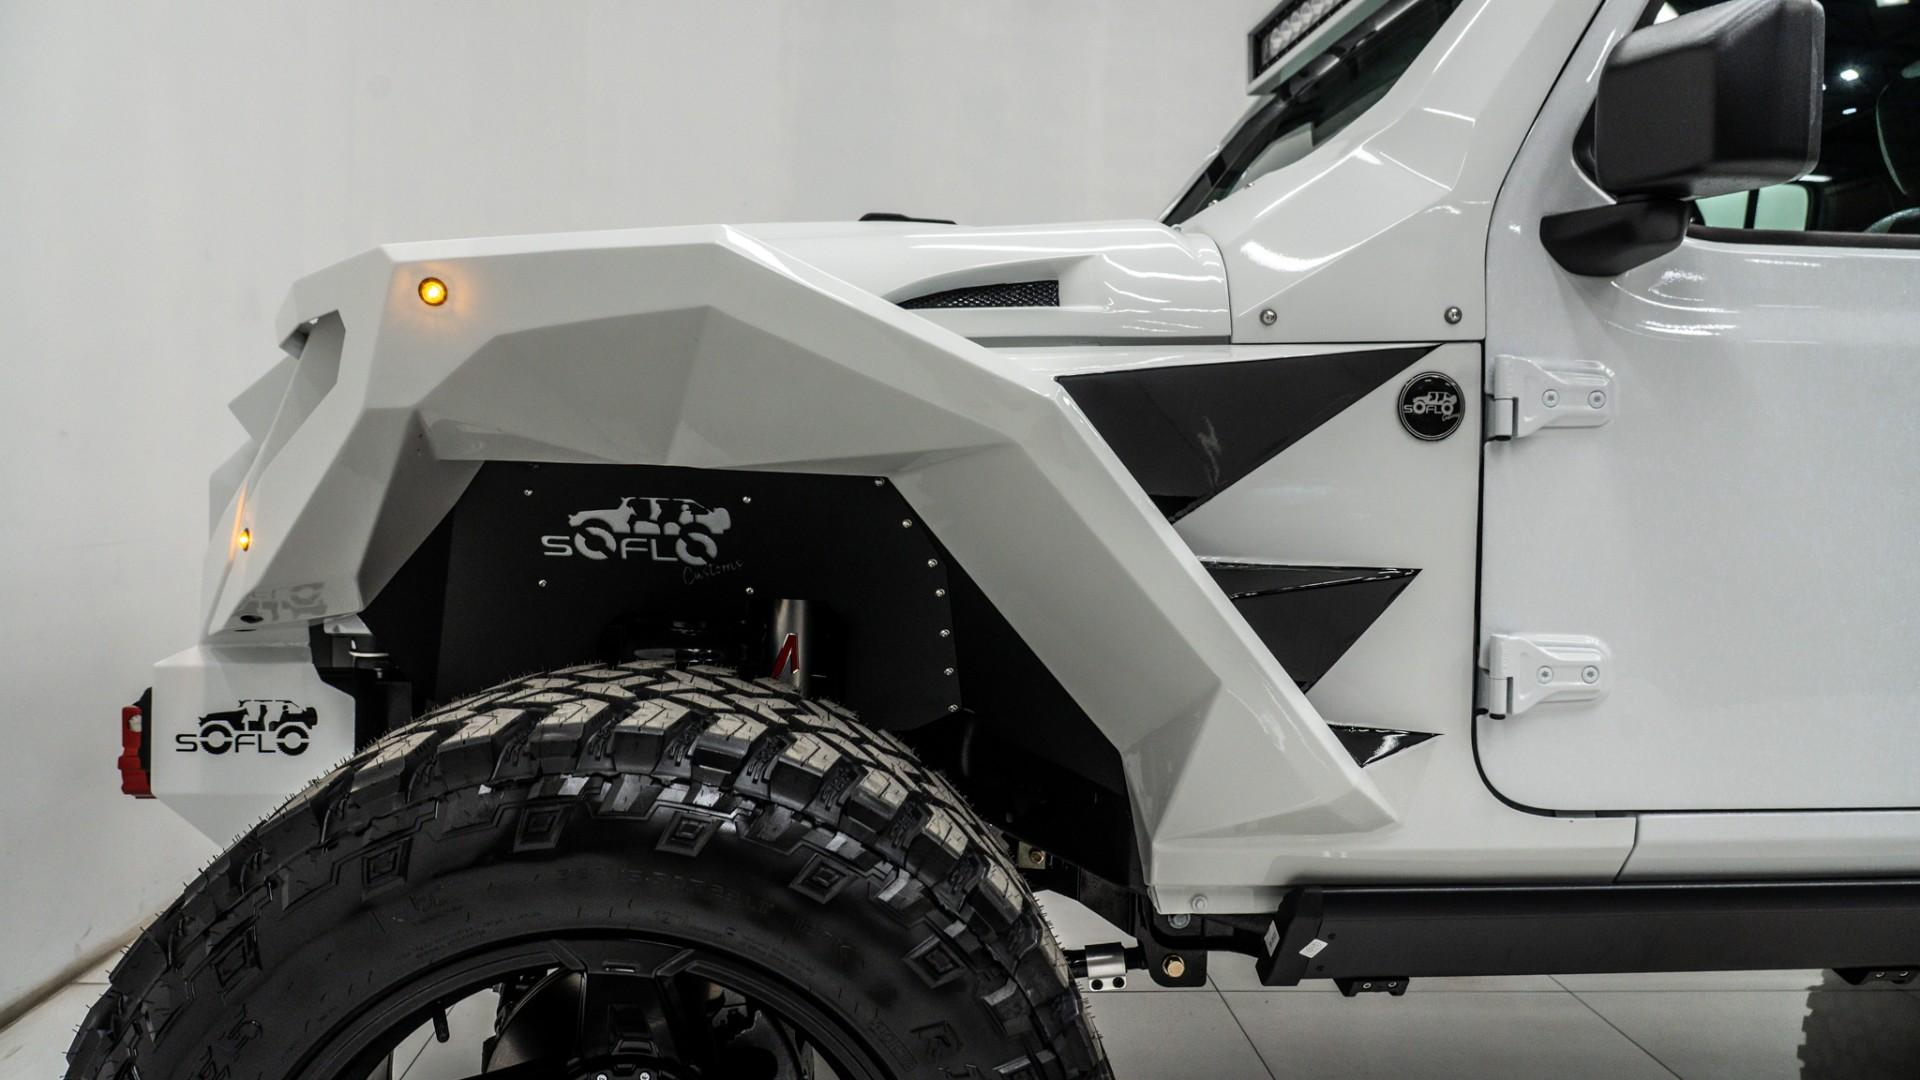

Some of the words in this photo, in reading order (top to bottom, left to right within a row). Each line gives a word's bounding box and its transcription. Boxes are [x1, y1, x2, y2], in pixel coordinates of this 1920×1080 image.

[1403, 401, 1454, 415] SOFLO
[540, 526, 718, 566] SOFLO
[175, 723, 310, 756] SOFLO
